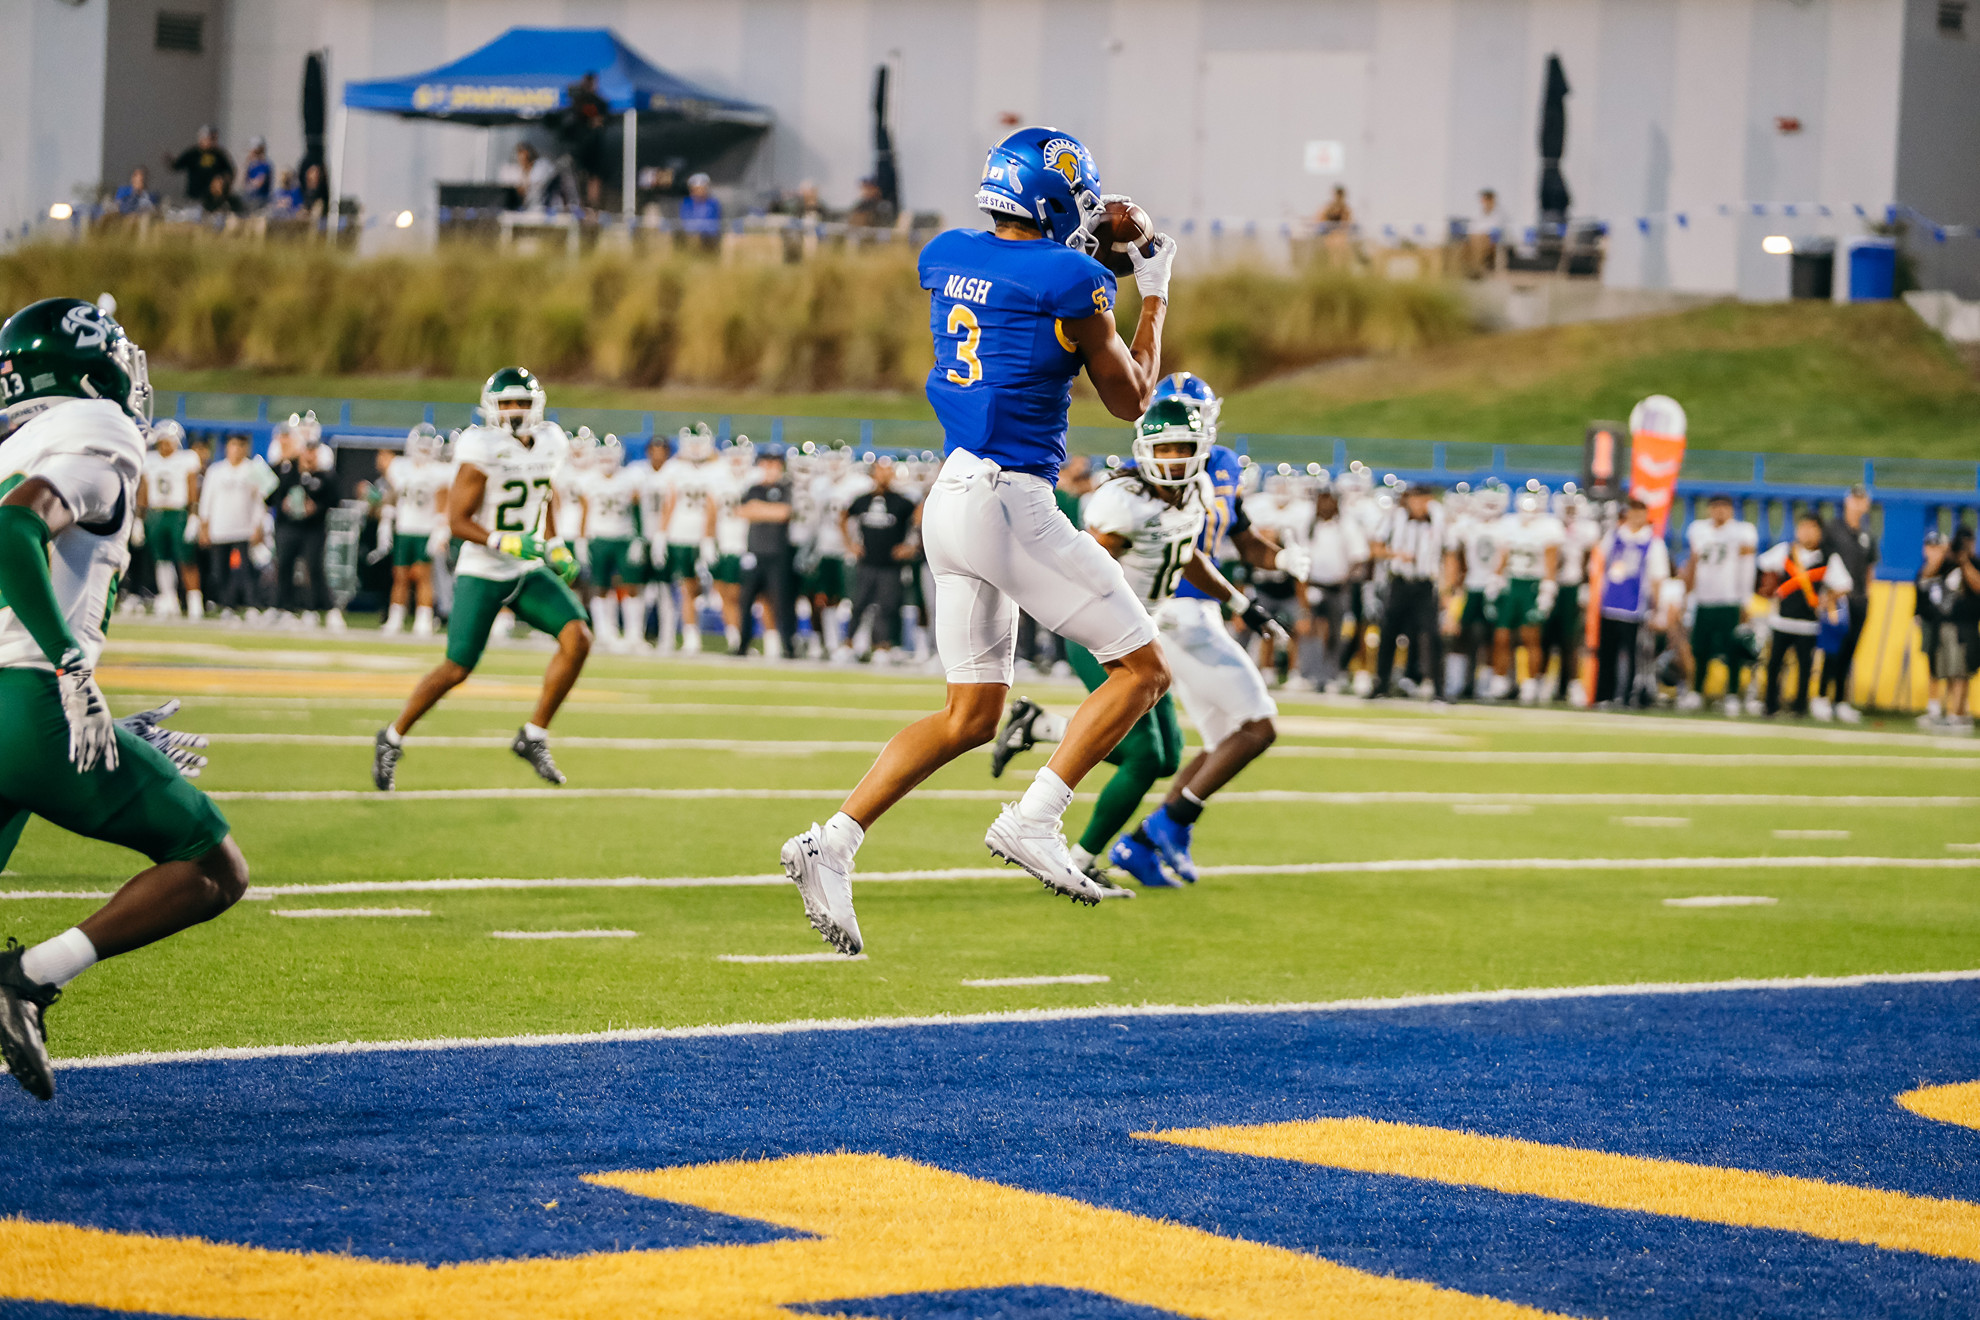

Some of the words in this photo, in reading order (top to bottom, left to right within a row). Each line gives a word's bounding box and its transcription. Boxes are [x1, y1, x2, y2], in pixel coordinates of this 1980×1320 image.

[990, 197, 1016, 212] STATE
[944, 274, 992, 304] NASH
[946, 303, 983, 387] 3
[496, 478, 551, 532] 27
